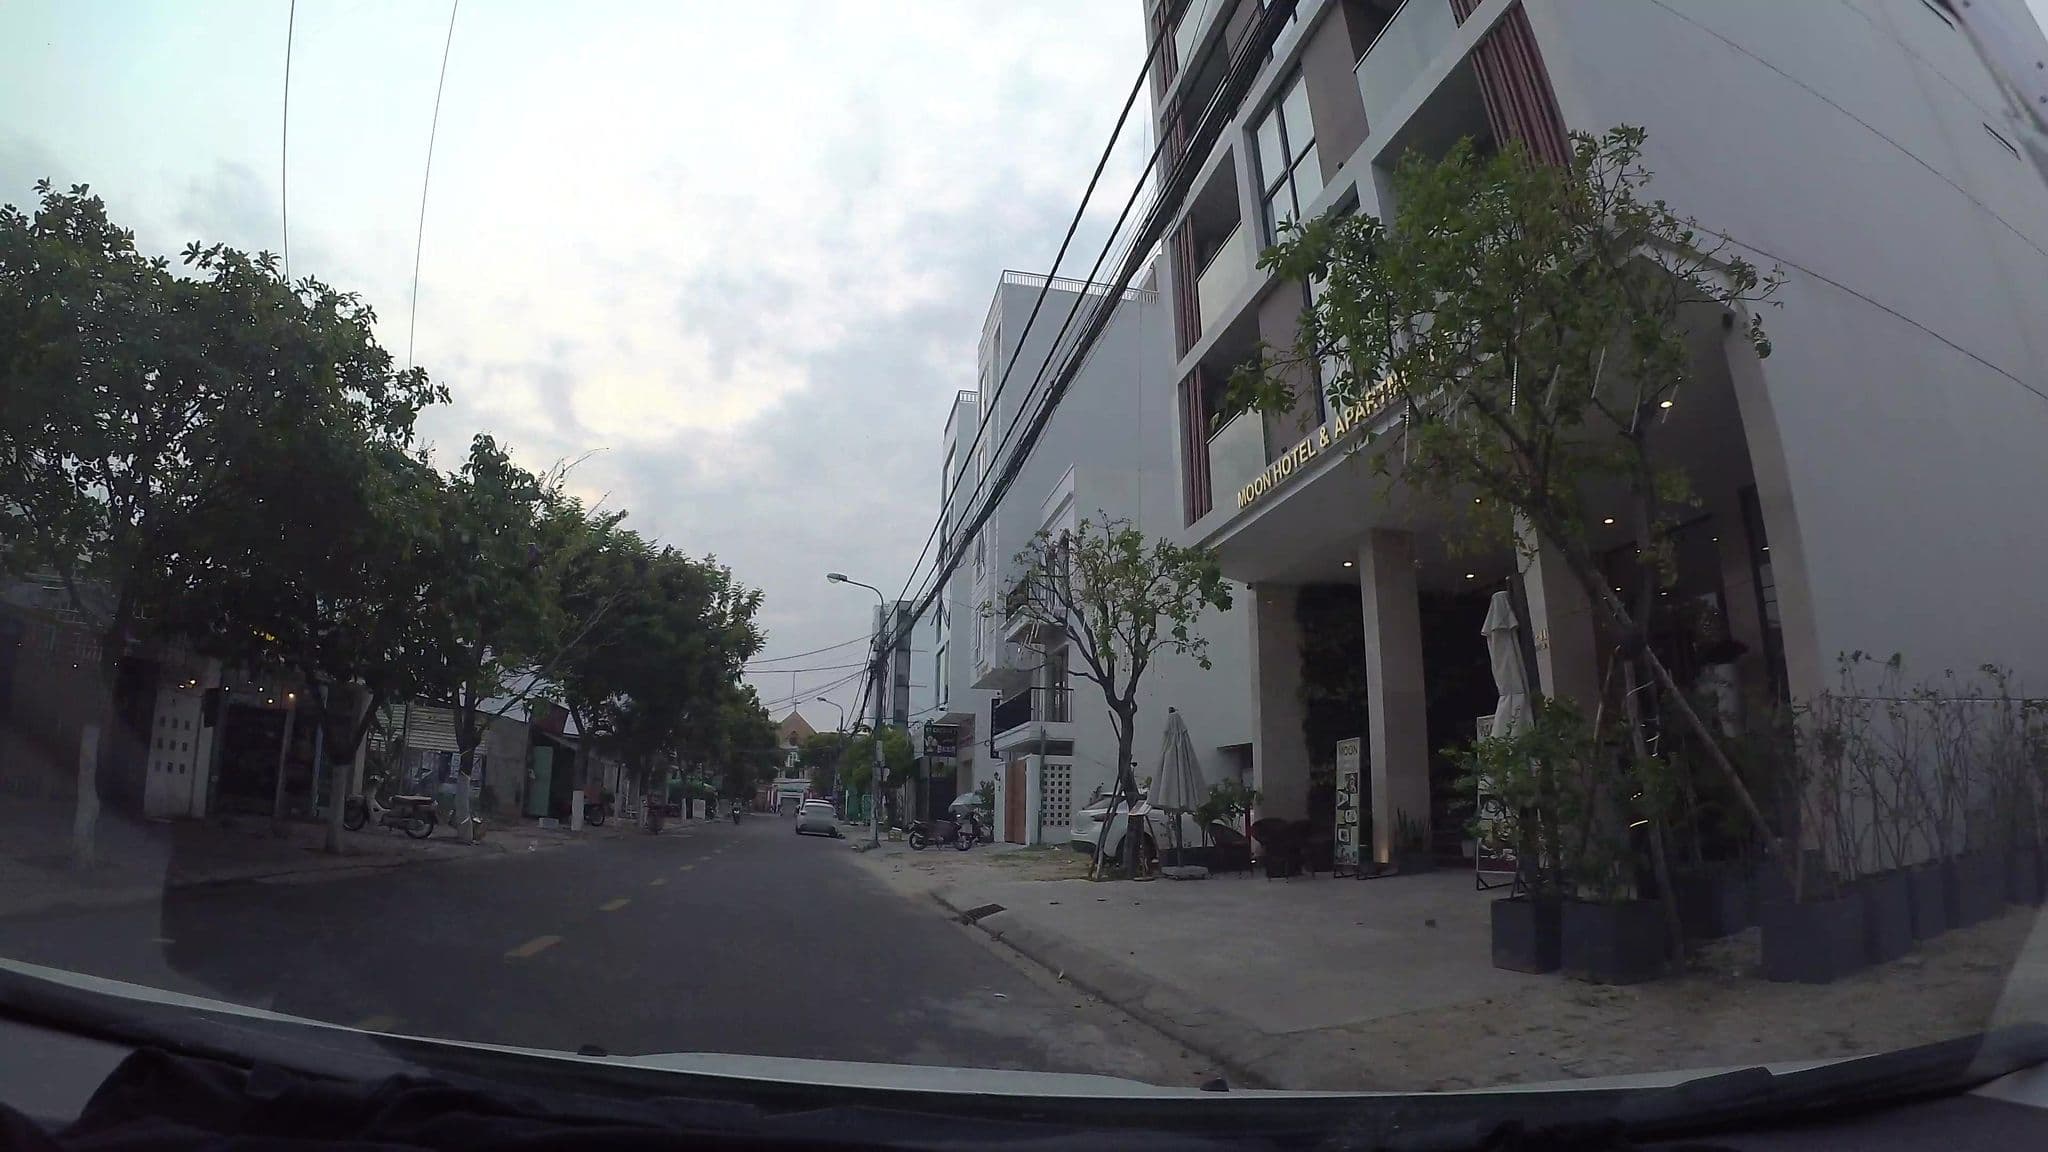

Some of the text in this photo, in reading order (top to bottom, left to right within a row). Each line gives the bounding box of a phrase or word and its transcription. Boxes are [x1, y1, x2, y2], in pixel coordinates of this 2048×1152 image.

[1237, 466, 1272, 509] MOON
[1273, 439, 1317, 483] HOTEL
[1319, 426, 1330, 447] &
